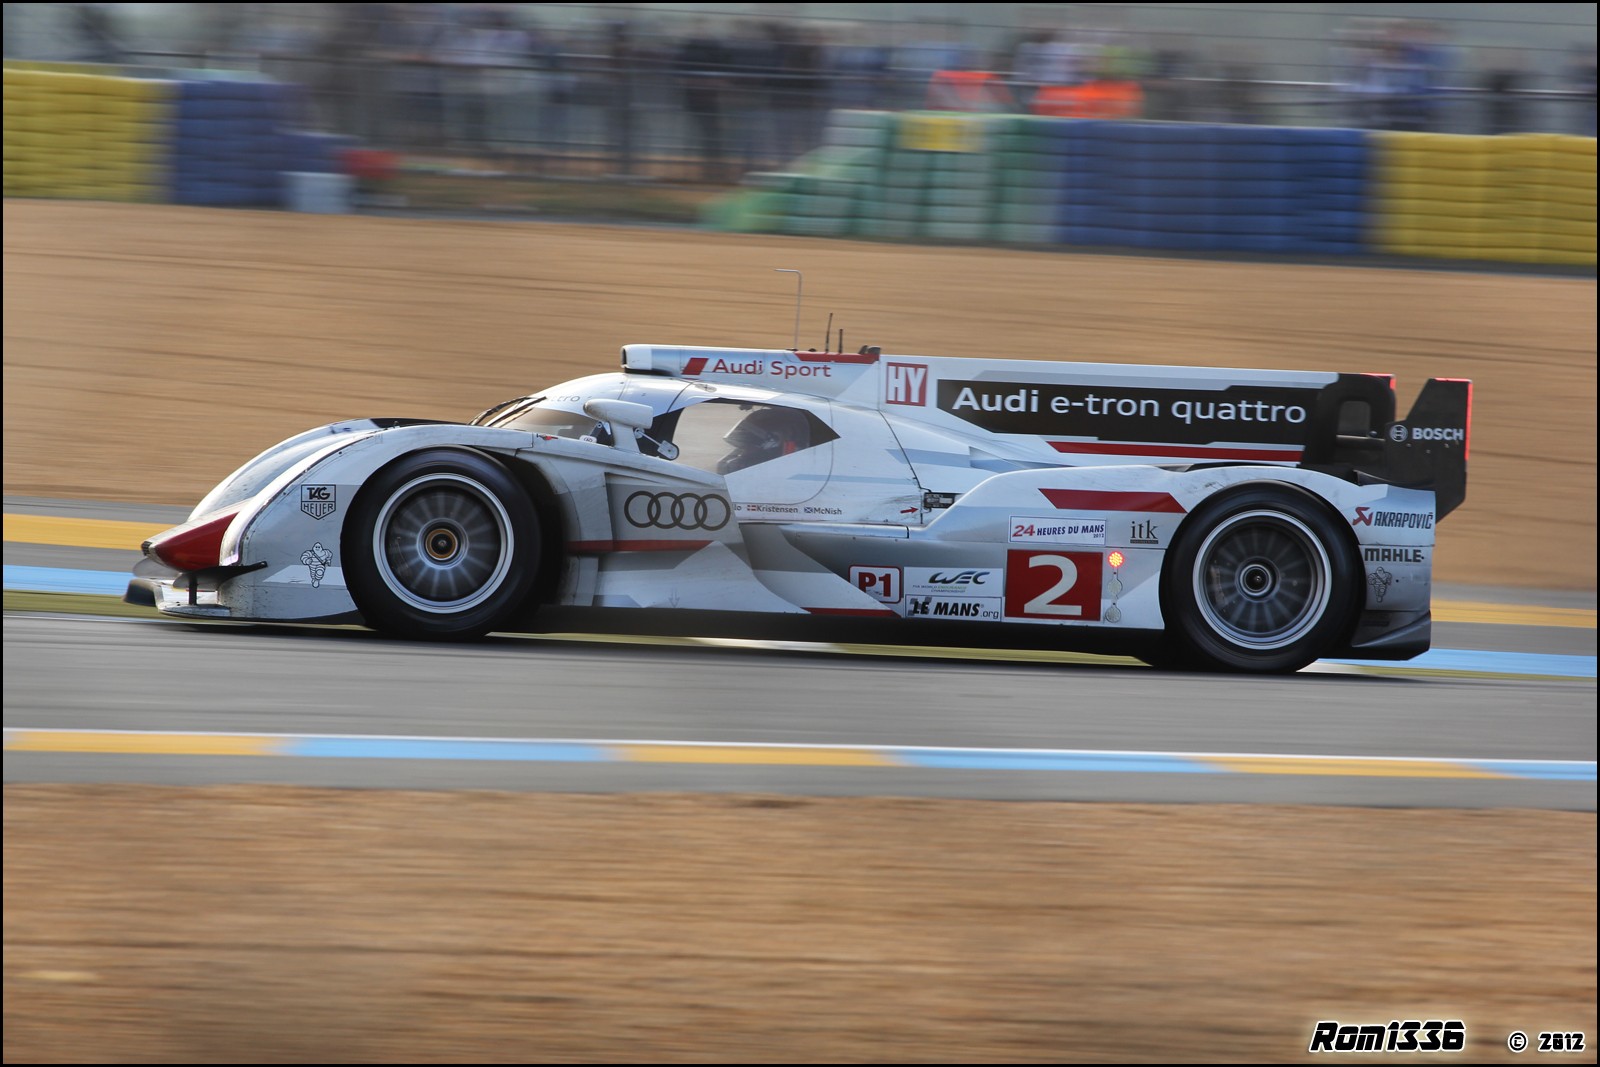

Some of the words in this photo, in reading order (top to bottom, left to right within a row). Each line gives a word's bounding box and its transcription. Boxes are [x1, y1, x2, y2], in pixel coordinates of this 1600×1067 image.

[712, 358, 763, 375] Audi
[770, 360, 831, 380] Sport
[887, 365, 927, 404] HY
[952, 387, 1039, 412] Audi
[1050, 392, 1160, 417] e-tron
[1171, 398, 1307, 424] quattro
[1412, 427, 1464, 441] BOSCH
[306, 486, 331, 500] TAG
[303, 503, 334, 518] HEUER
[756, 505, 798, 514] Kristensen
[813, 507, 842, 515] McNish
[1012, 524, 1035, 538] 24
[1037, 526, 1066, 536] HEURES
[1068, 526, 1080, 535] DU
[1081, 524, 1104, 534] MANS
[1130, 519, 1158, 539] itk
[1364, 548, 1422, 562] MAHLE
[858, 572, 891, 597] P1
[928, 571, 990, 585] WEC
[1023, 554, 1082, 616] 2
[912, 600, 929, 614] LE
[934, 602, 980, 617] MANS
